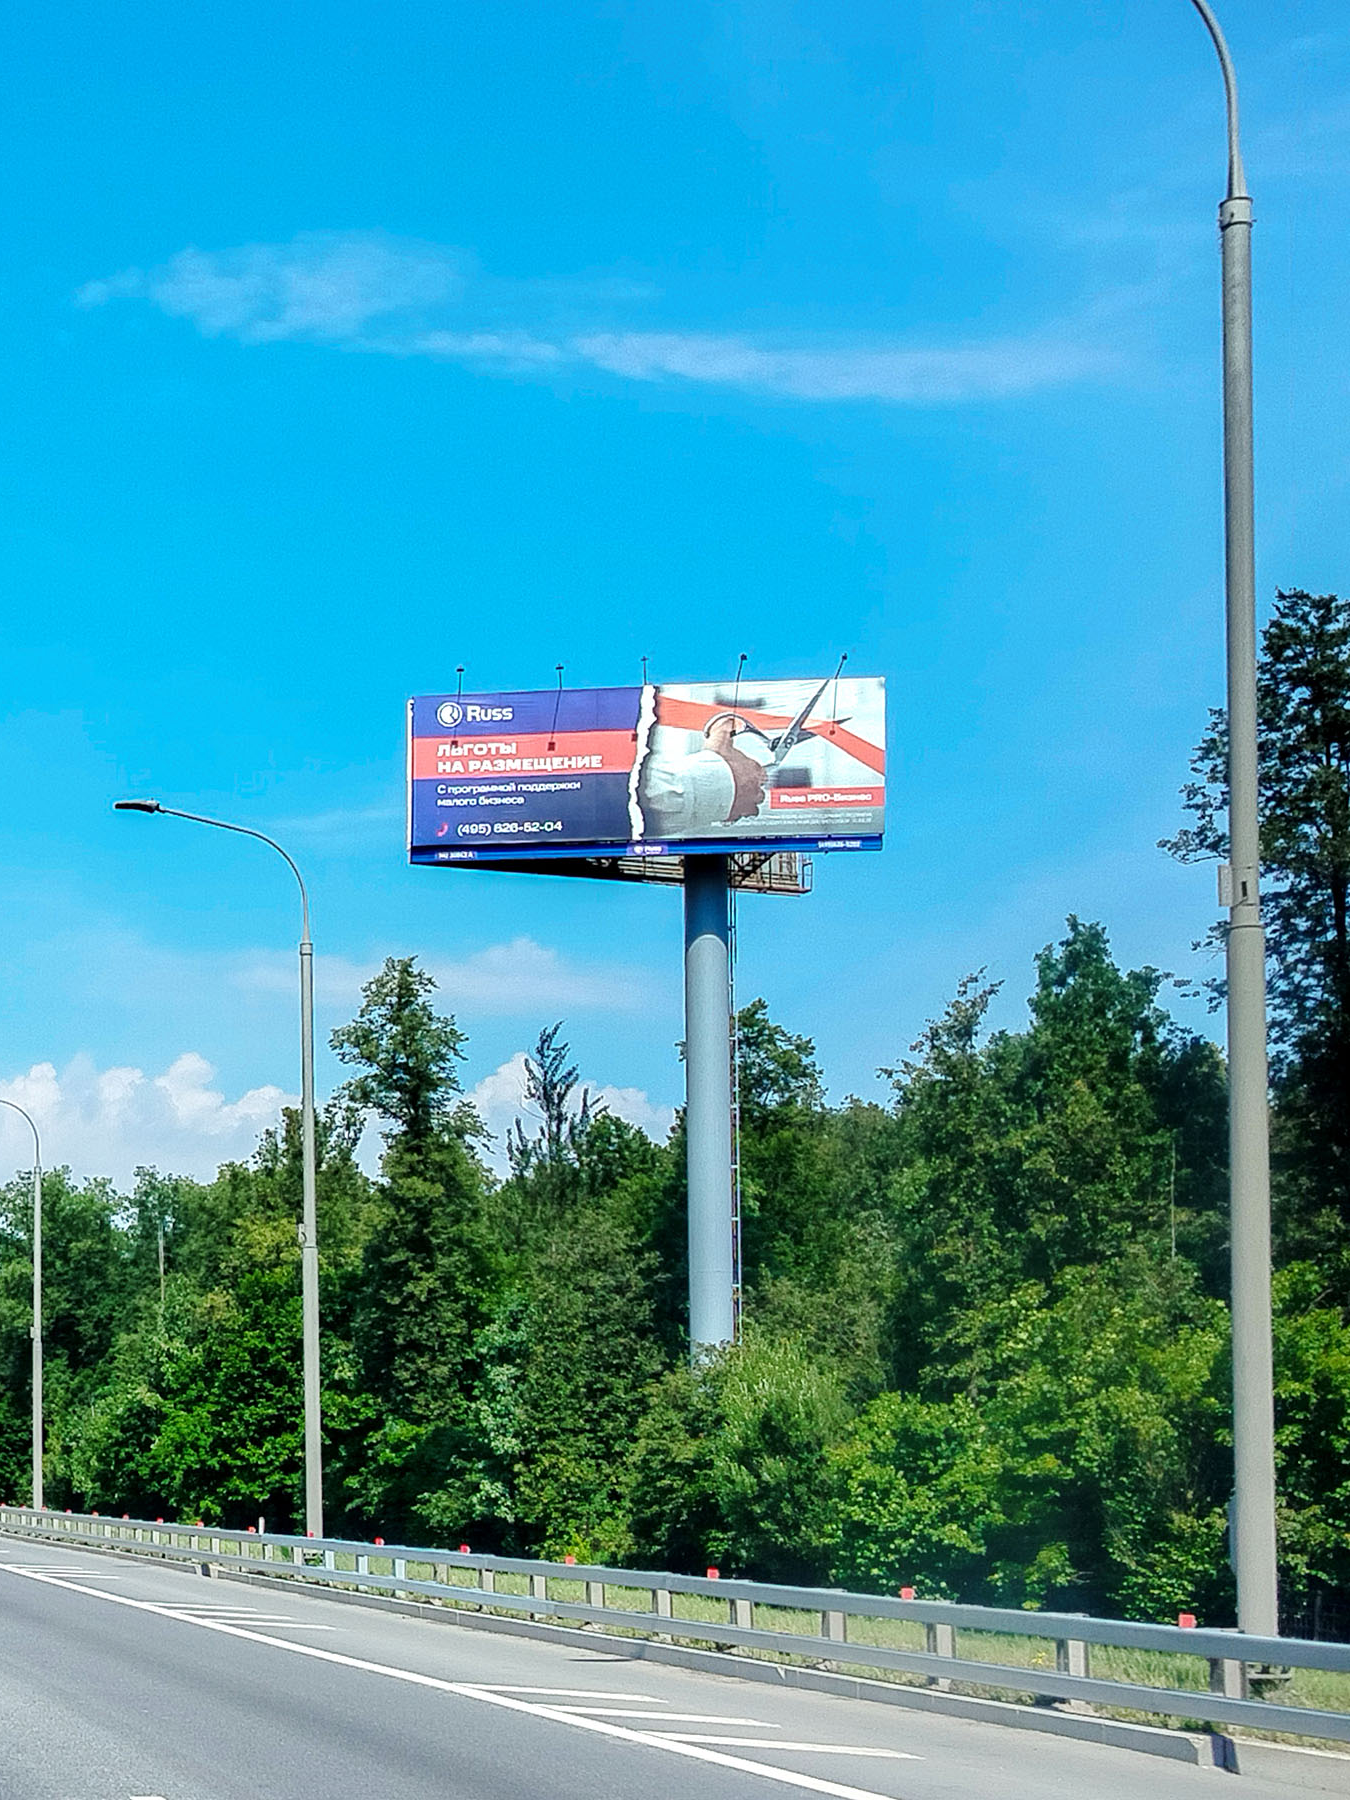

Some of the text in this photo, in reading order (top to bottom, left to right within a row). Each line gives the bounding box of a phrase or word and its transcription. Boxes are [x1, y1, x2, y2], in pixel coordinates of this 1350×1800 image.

[466, 705, 514, 722] Russ
[436, 742, 517, 757] ЛЬГОТЫ
[437, 755, 603, 774] НА РАЗМЕЩЕНИЕ
[437, 781, 581, 796] С программой поддержки
[436, 795, 525, 807] малого бизнеса
[457, 823, 492, 837] (495)
